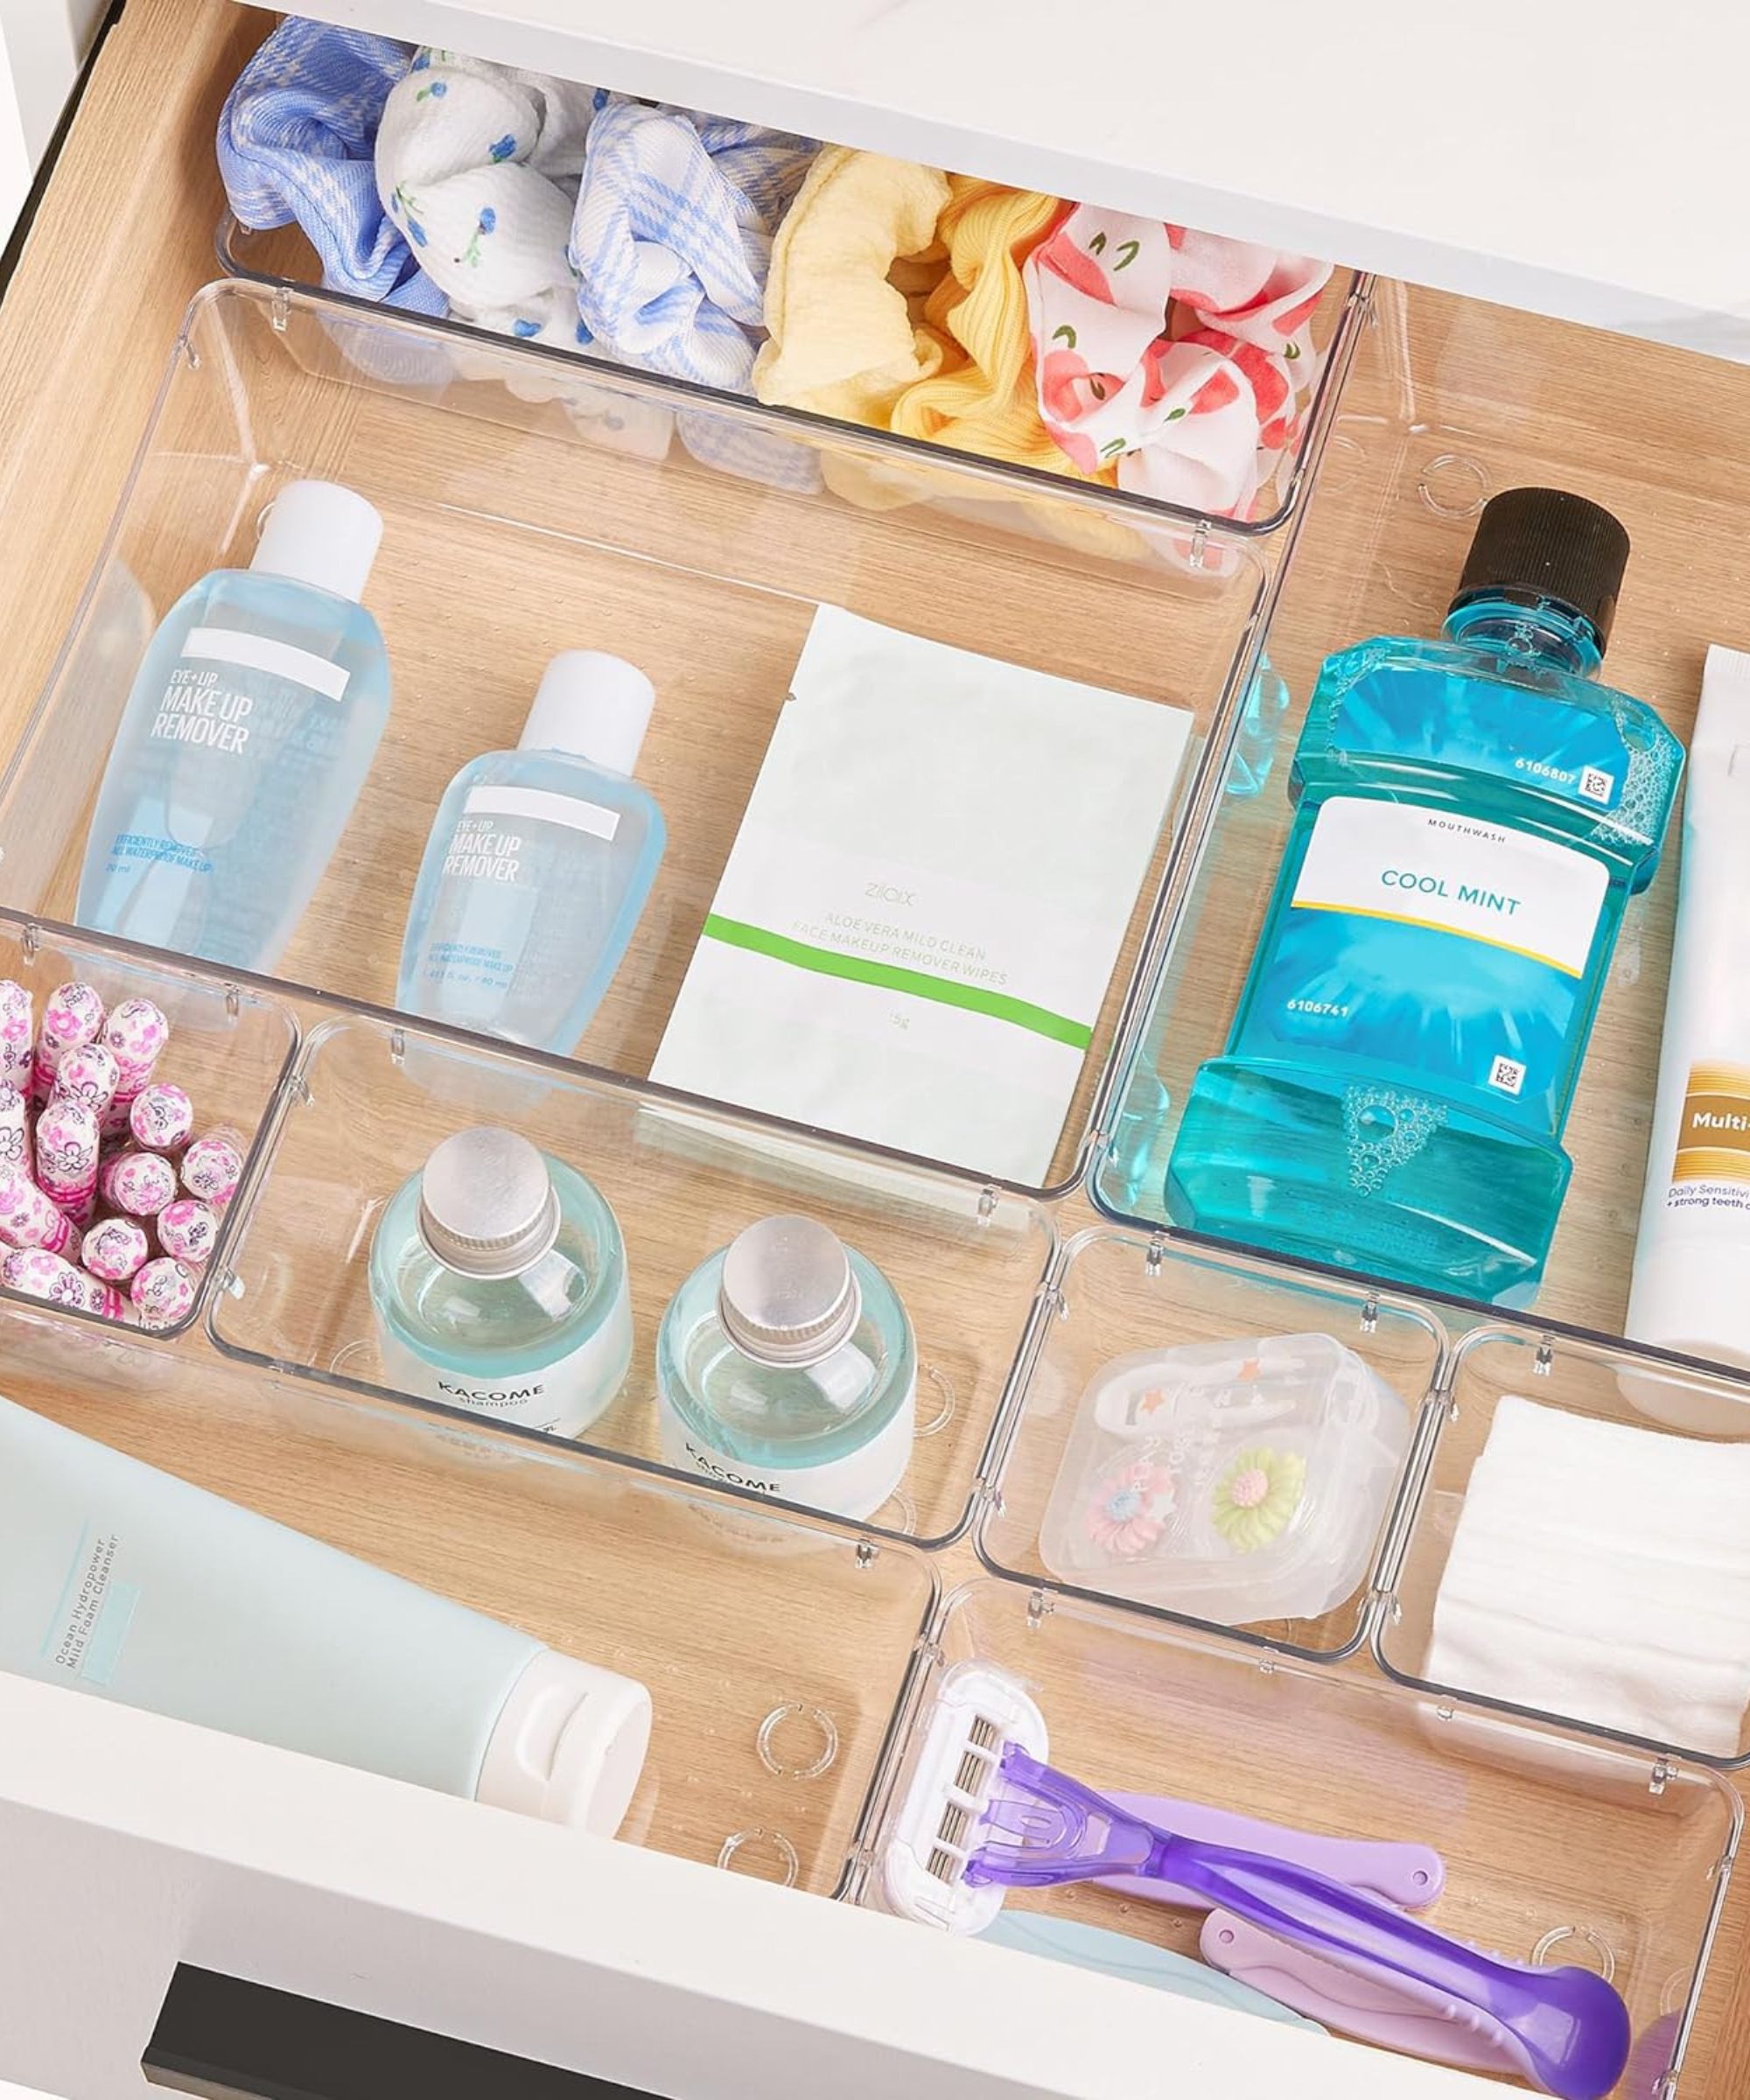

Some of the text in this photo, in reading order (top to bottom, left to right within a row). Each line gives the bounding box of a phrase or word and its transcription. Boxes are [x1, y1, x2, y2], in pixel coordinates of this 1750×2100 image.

[159, 685, 253, 722] MAKE UP
[150, 712, 250, 754] REMOVER
[1515, 757, 1577, 785] 6106807
[448, 833, 522, 857] MAKE UP
[1427, 817, 1507, 844] MOUTHWASH
[442, 855, 520, 881] REMOVER
[1381, 870, 1522, 916] COOL MINT
[791, 921, 1008, 985] FACE MAKEUP REMOVER WIPES
[825, 913, 987, 961] ALOE VERA MILD CLEAN
[1286, 998, 1351, 1018] 6106741
[1669, 1186, 1697, 1198] Daily
[1674, 1198, 1710, 1208] strong
[1712, 1197, 1744, 1208] teeth
[438, 1381, 544, 1401] KACOME
[685, 1442, 780, 1491] KACOME
[55, 1538, 106, 1664] Ocean Hydropower
[66, 1534, 120, 1670] Mild Foam Cleanser
